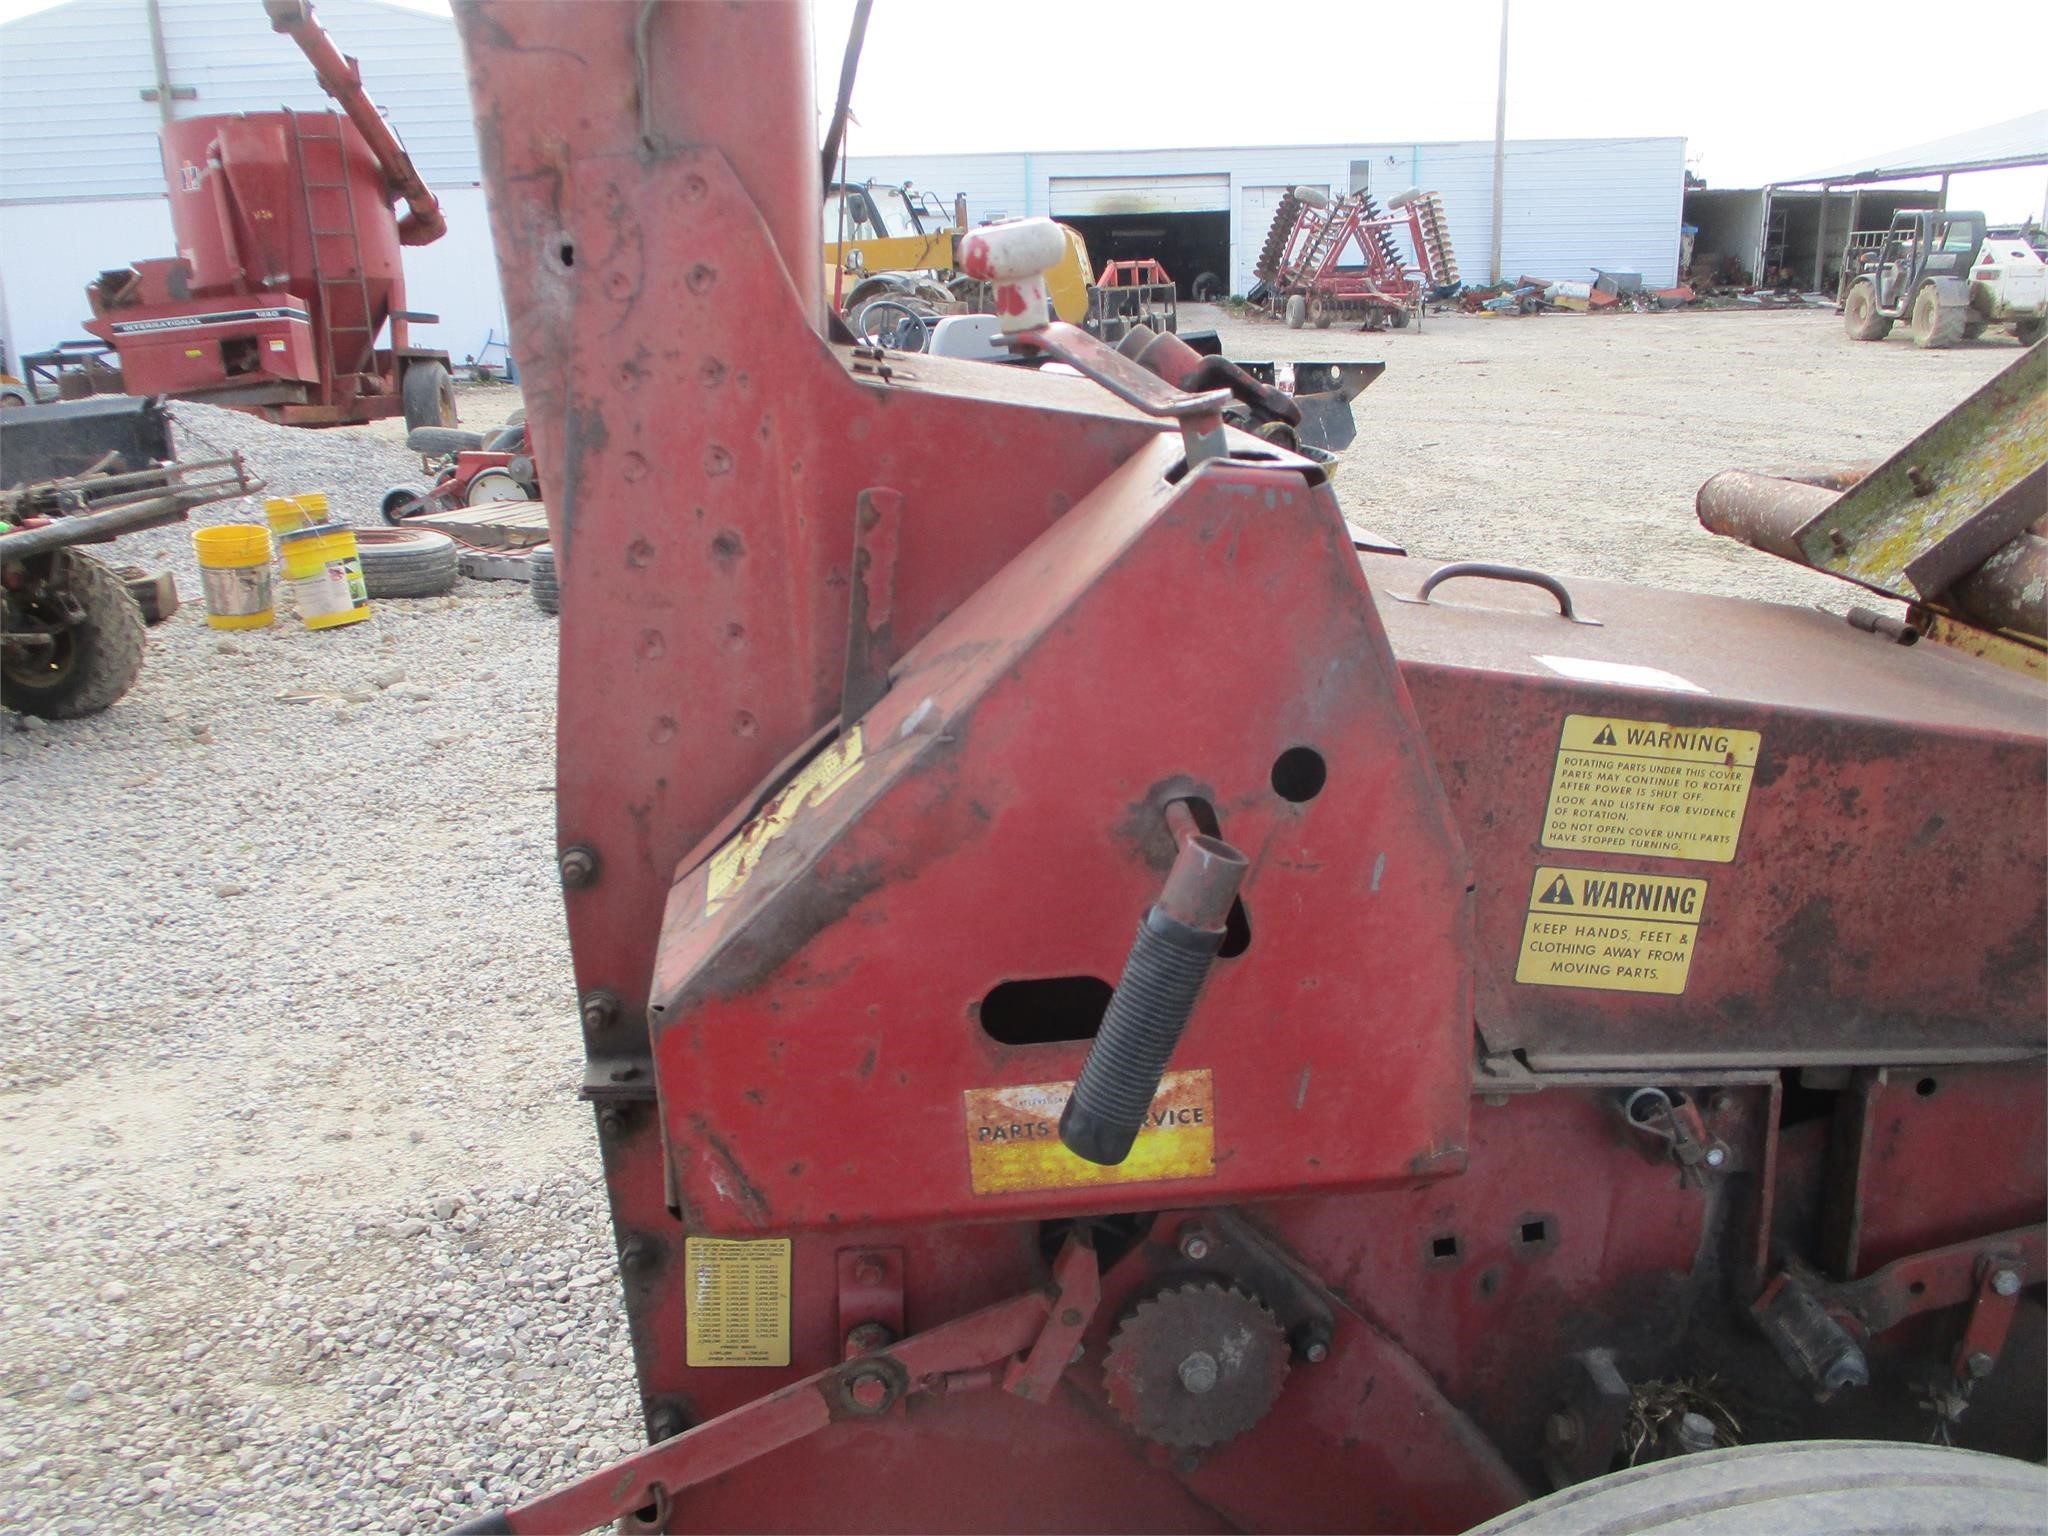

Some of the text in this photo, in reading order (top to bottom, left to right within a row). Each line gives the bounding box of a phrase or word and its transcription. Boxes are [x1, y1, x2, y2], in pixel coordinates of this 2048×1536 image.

[123, 318, 203, 332] INTERNATIONAL
[1627, 728, 1729, 753] WARNING
[1564, 757, 1743, 780] ROTATING PARTS UNDER THIS COVER.
[1560, 782, 1703, 801] AFTER POWER IS SHUT OFF.
[1562, 770, 1741, 792] PARTS MAY CONTINUE TO ROTATE
[1555, 807, 1629, 821] OF ROTATION.
[1556, 795, 1736, 818] LOOK AND LISTEN FOR EVIDENCE
[1549, 832, 1681, 851] HAVE STOPPED TURNING.
[1552, 821, 1731, 844] DO NOT OPEN COVER UNTIL PARTS
[1582, 879, 1697, 915] WARNING
[1533, 922, 1688, 945] KEEP HANDS, FEET &
[1530, 941, 1685, 963] CLOTHING AWAY FROM
[1550, 962, 1659, 980] MOVING PARTS.
[978, 1122, 1049, 1142] PARTS
